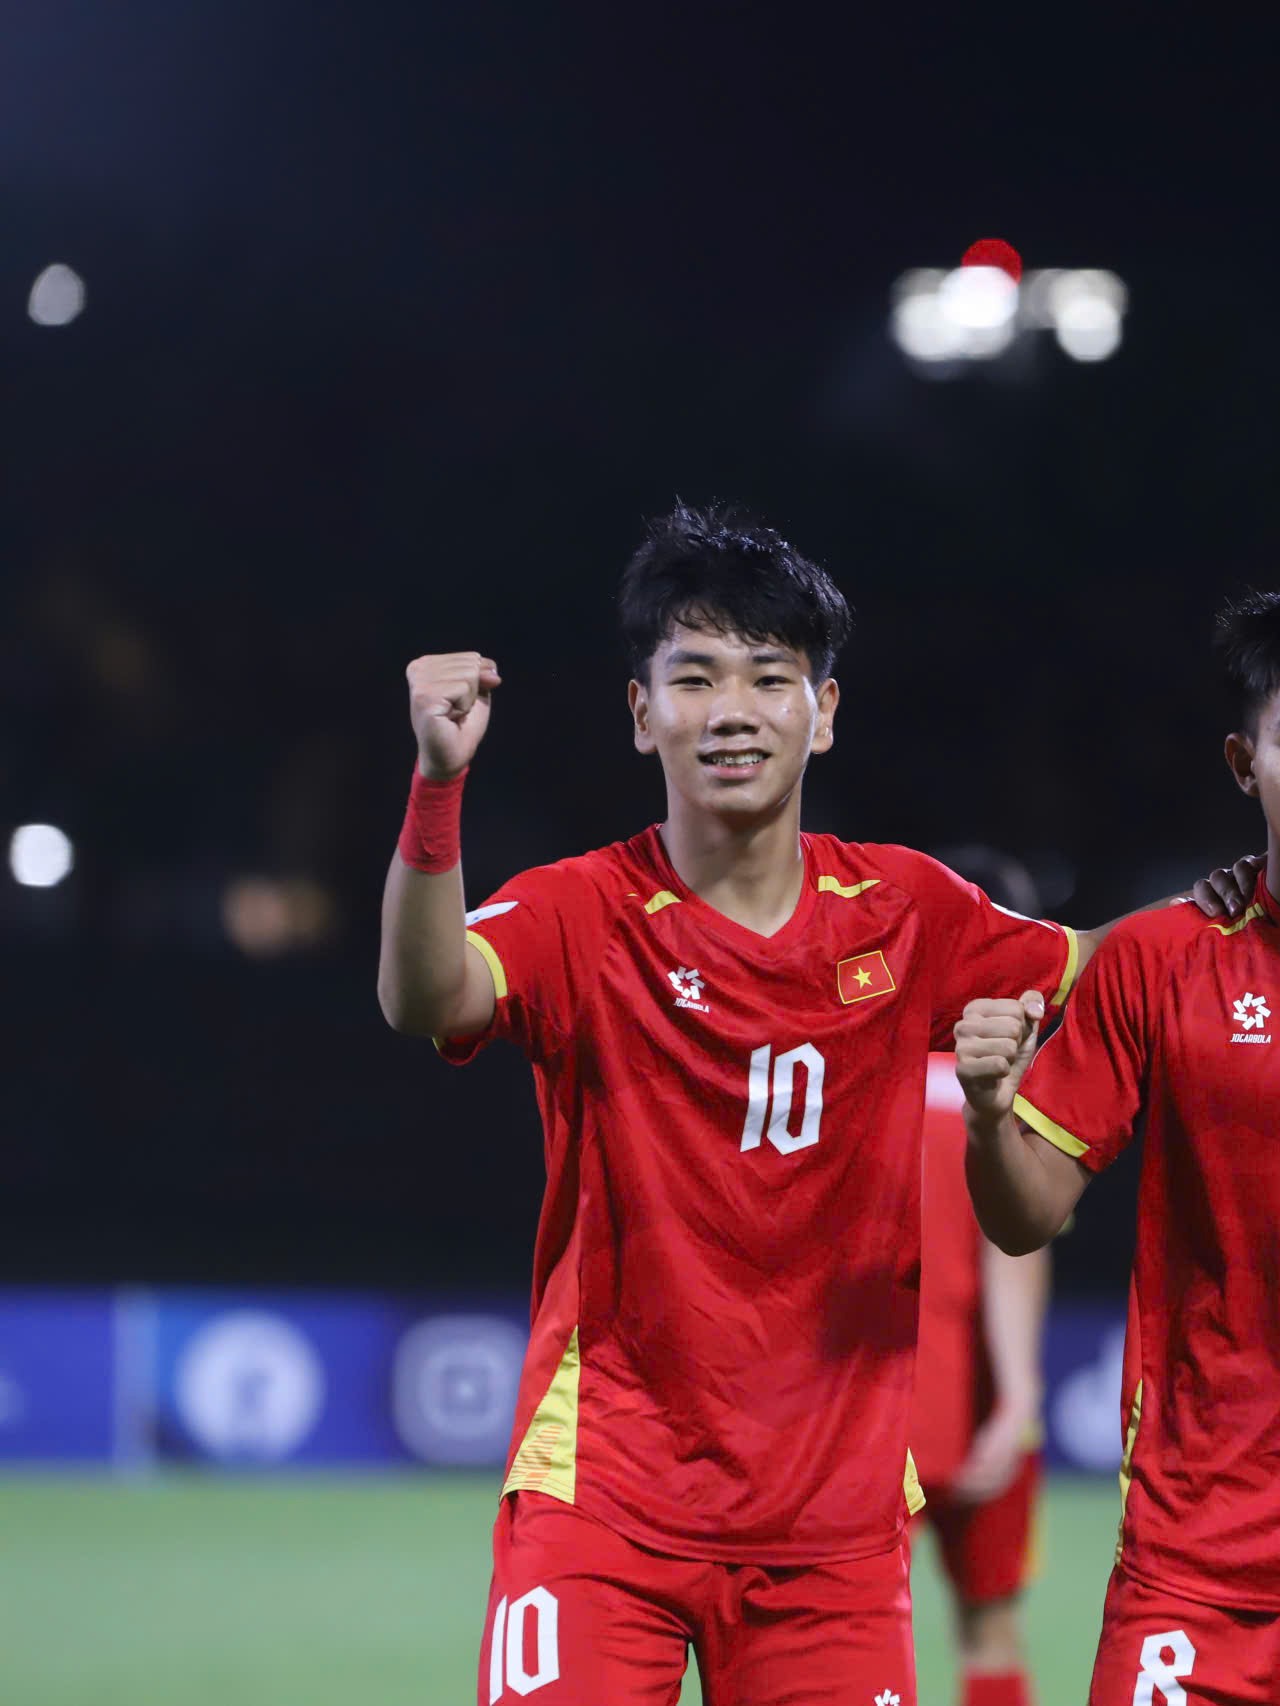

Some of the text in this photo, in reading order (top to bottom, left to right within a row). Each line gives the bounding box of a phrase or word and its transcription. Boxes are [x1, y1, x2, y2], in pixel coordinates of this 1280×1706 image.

[1230, 1033, 1271, 1044] JOGARBOLA
[740, 1043, 825, 1155] 10
[489, 1586, 560, 1706] 10
[1133, 1630, 1196, 1706] 8
